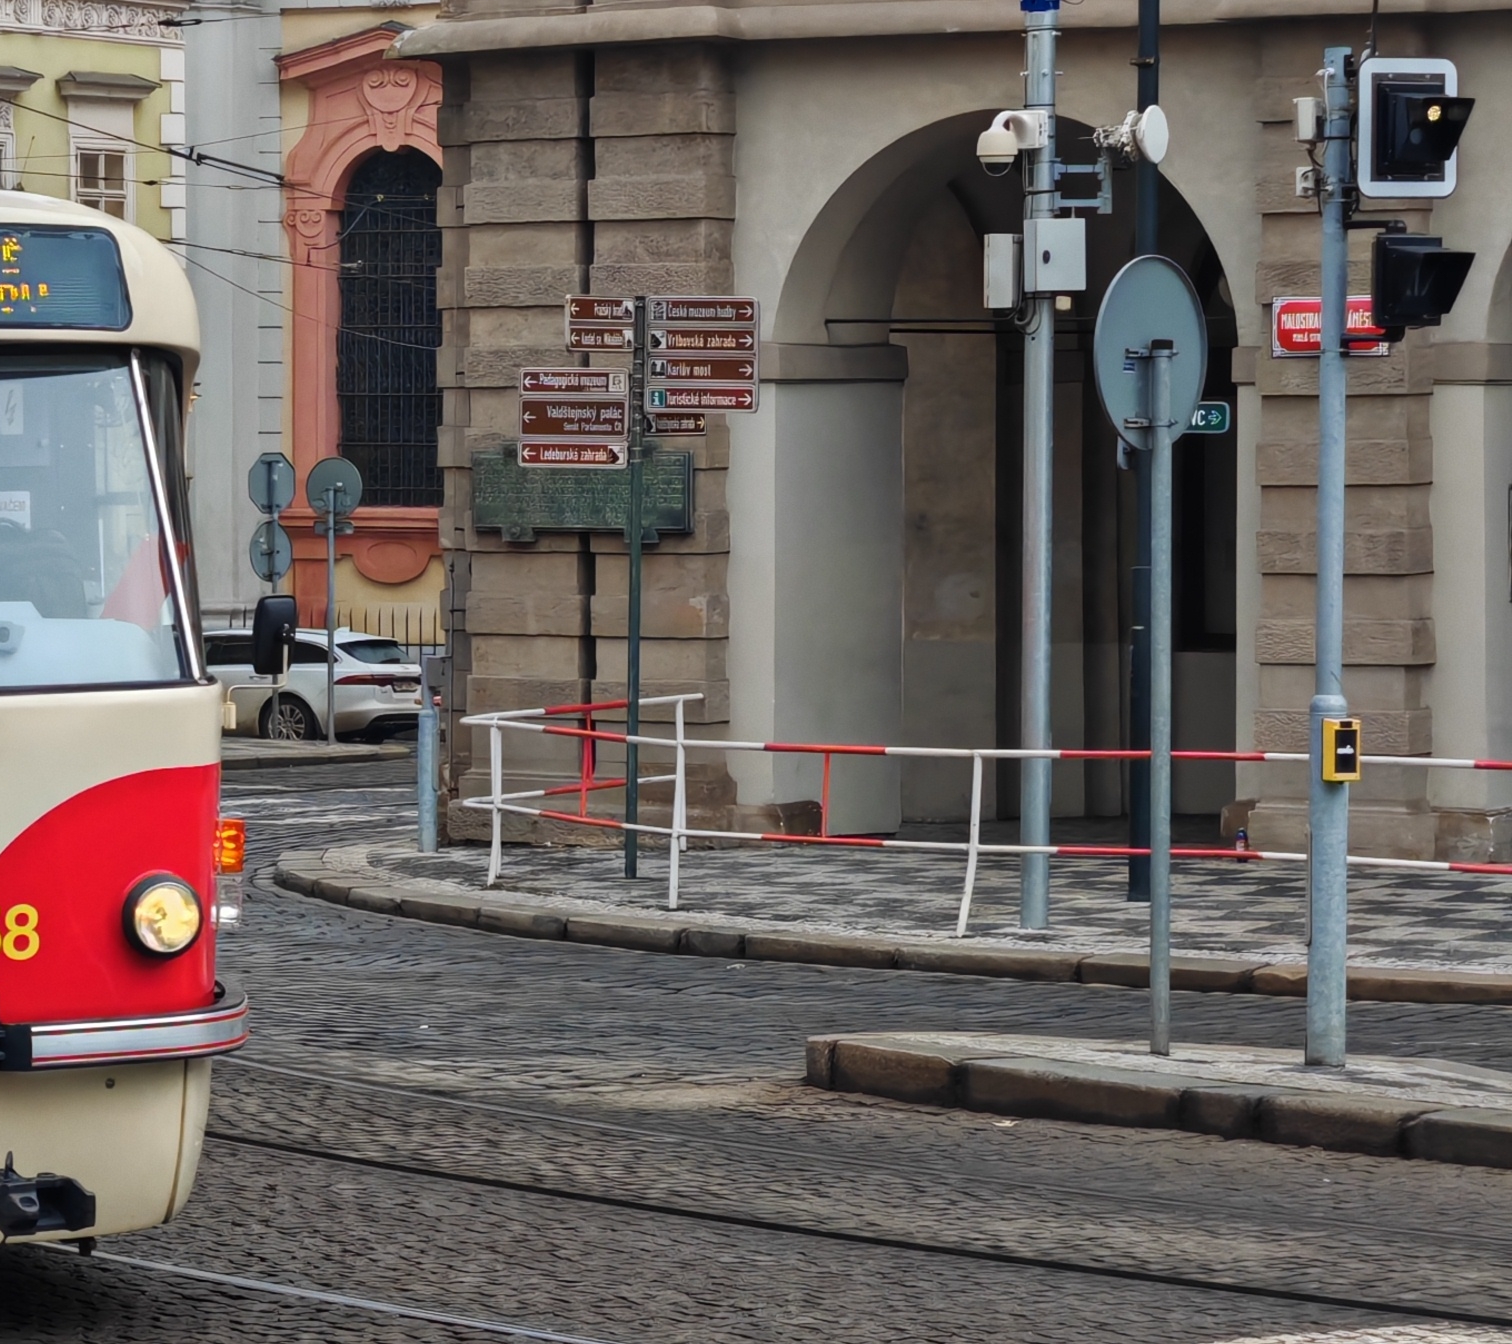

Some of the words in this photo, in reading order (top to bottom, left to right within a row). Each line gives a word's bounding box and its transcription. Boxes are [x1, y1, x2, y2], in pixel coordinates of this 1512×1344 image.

[1281, 312, 1322, 330] MALOSTRA
[707, 335, 736, 348] zahrada
[693, 364, 711, 376] most
[666, 391, 699, 406] Turistické
[700, 393, 736, 406] informace
[546, 405, 596, 422] Valdštejnský
[599, 405, 622, 422] palác
[540, 446, 578, 460] Ledeburská
[580, 447, 607, 460] zahrada
